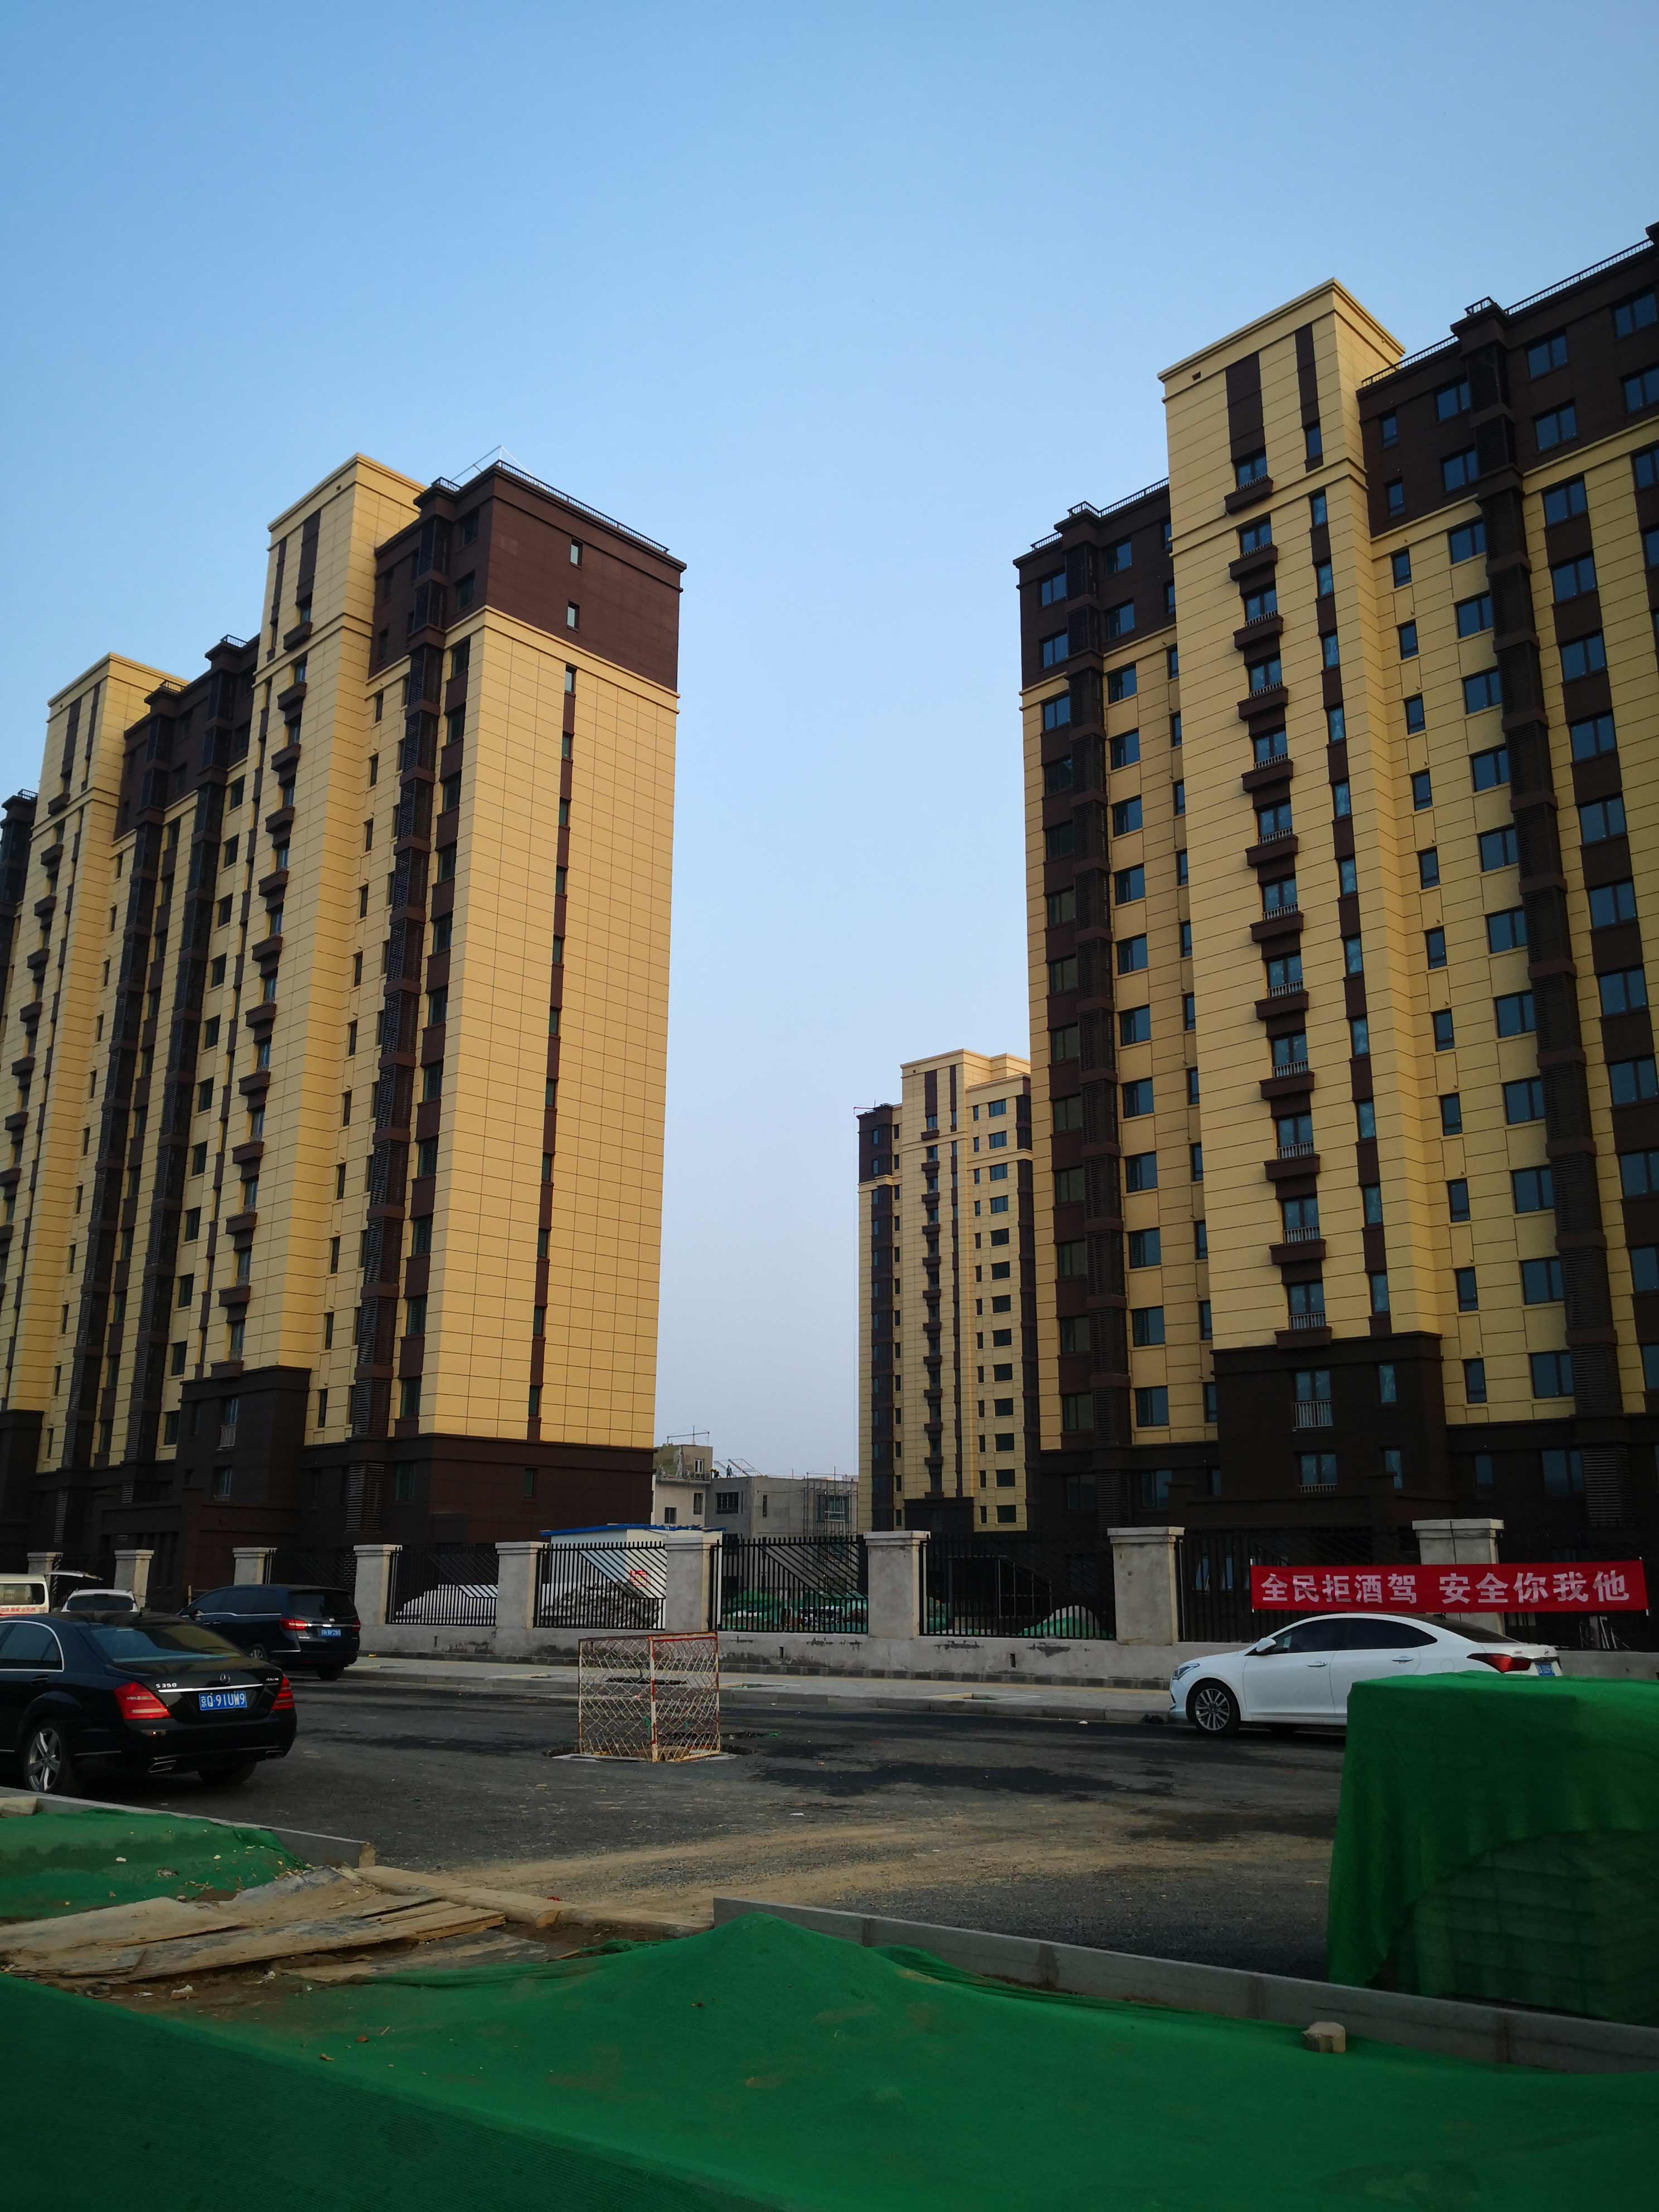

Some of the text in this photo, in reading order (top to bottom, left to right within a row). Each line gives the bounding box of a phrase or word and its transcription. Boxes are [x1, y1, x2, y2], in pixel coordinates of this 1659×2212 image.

[1261, 1570, 1629, 1604] 全民拒酒驾 安全你我他
